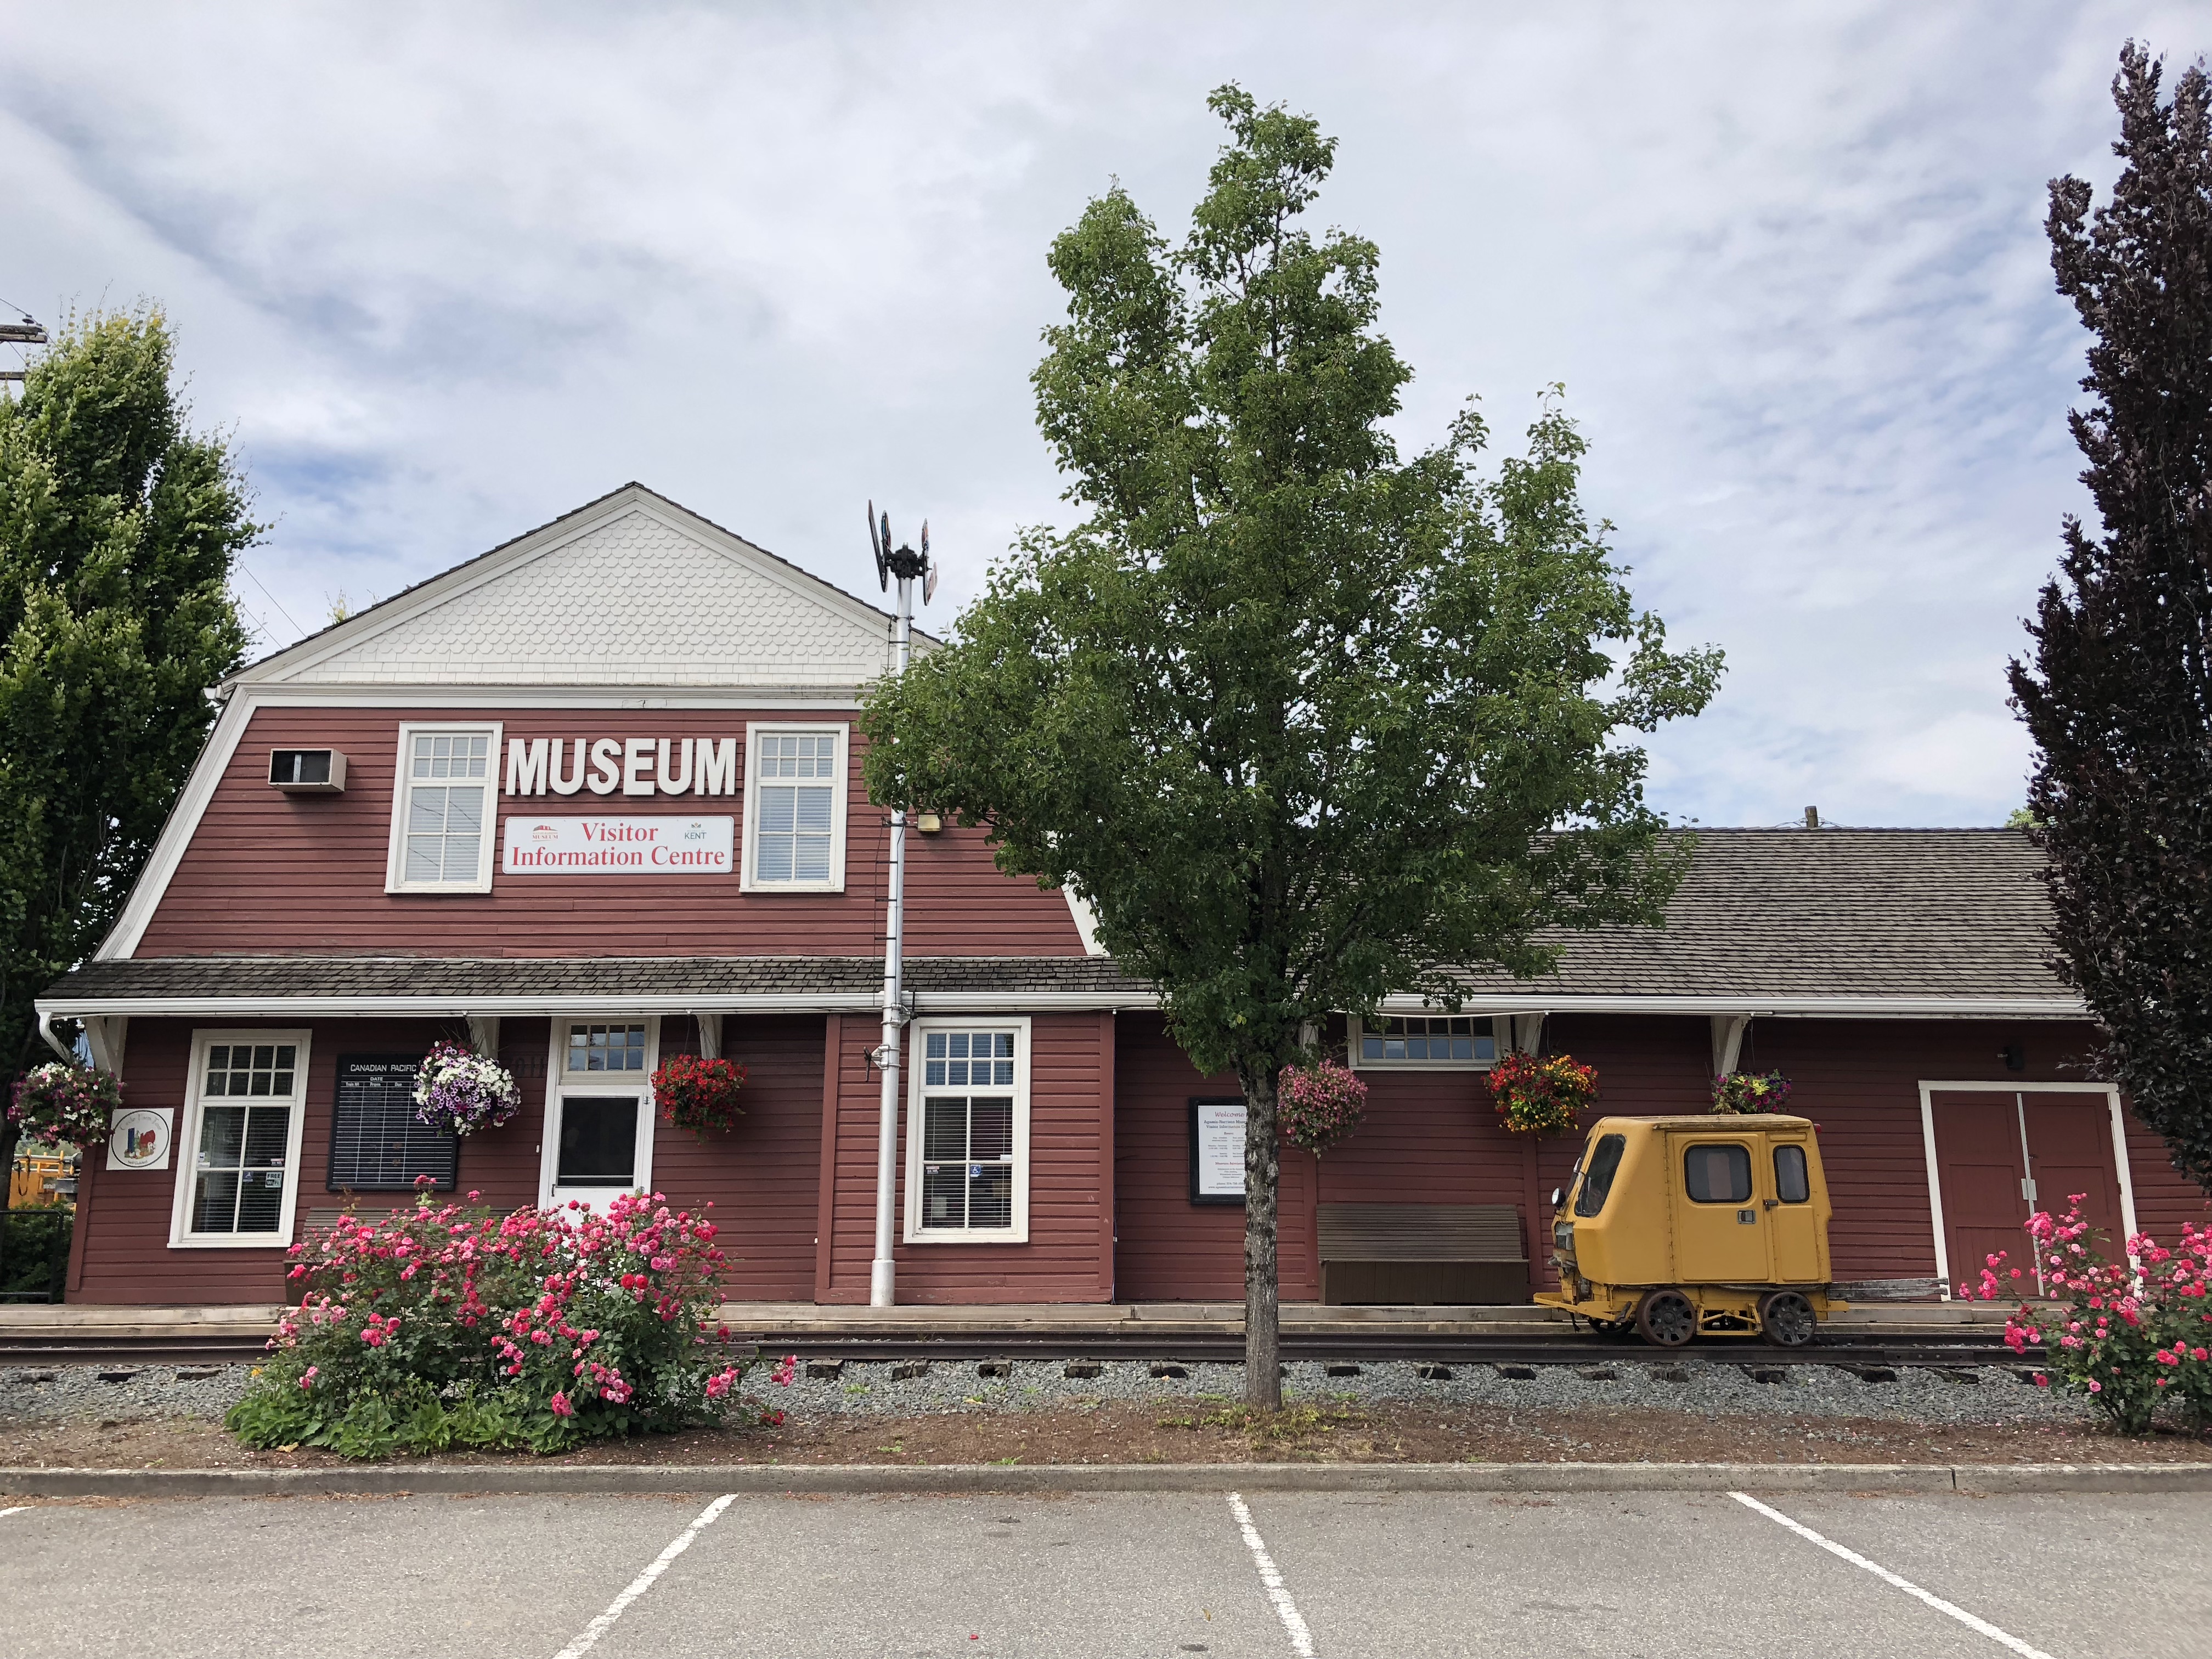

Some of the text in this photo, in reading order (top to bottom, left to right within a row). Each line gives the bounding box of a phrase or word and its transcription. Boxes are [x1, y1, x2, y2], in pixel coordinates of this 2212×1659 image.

[505, 738, 735, 795] MUSEUM
[580, 822, 659, 842] Visitor
[511, 845, 725, 866] Information Centre
